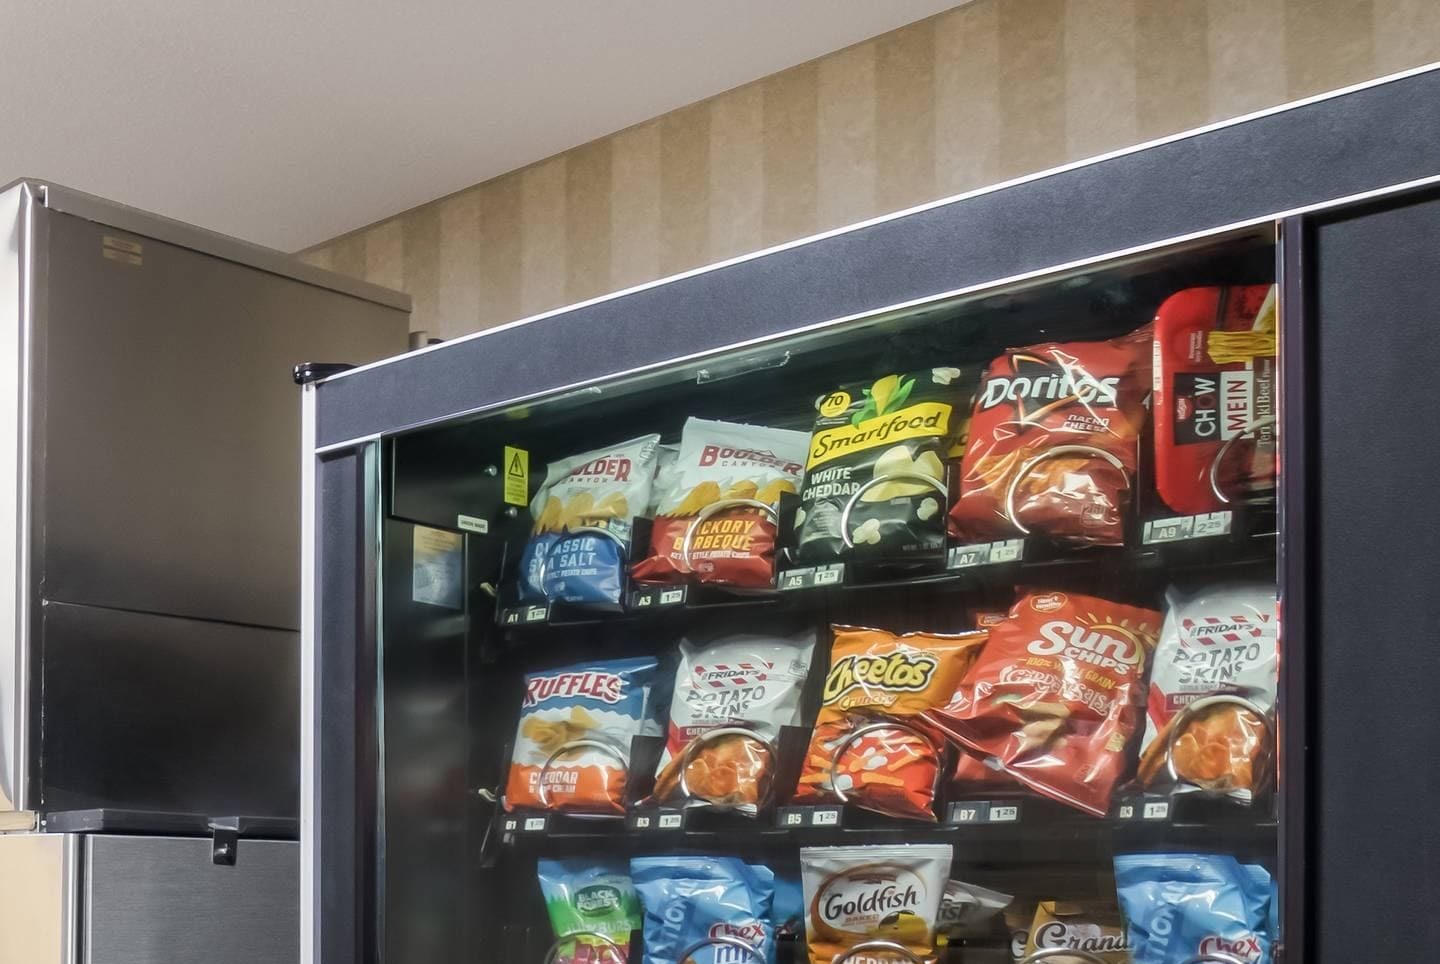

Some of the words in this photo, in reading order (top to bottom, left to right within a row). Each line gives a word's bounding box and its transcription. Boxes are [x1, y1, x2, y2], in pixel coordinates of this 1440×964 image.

[979, 374, 1120, 408] Doritos
[1227, 380, 1247, 431] MEIN
[1195, 377, 1216, 437] CHOW
[813, 411, 942, 459] Smartfood
[699, 446, 802, 475] BOULDER
[811, 467, 851, 485] WHITE
[803, 481, 860, 501] CHEDDAR
[560, 552, 596, 567] SALT
[960, 553, 975, 565] A7
[788, 576, 802, 586] A5
[639, 596, 651, 606] A3
[1027, 621, 1140, 664] Sun
[1064, 646, 1130, 675] CHIPS
[524, 672, 621, 706] RUFFLES
[824, 654, 934, 702] Cheetos
[788, 813, 802, 825] B5
[960, 810, 976, 822] B7
[825, 885, 917, 921] Goldfish
